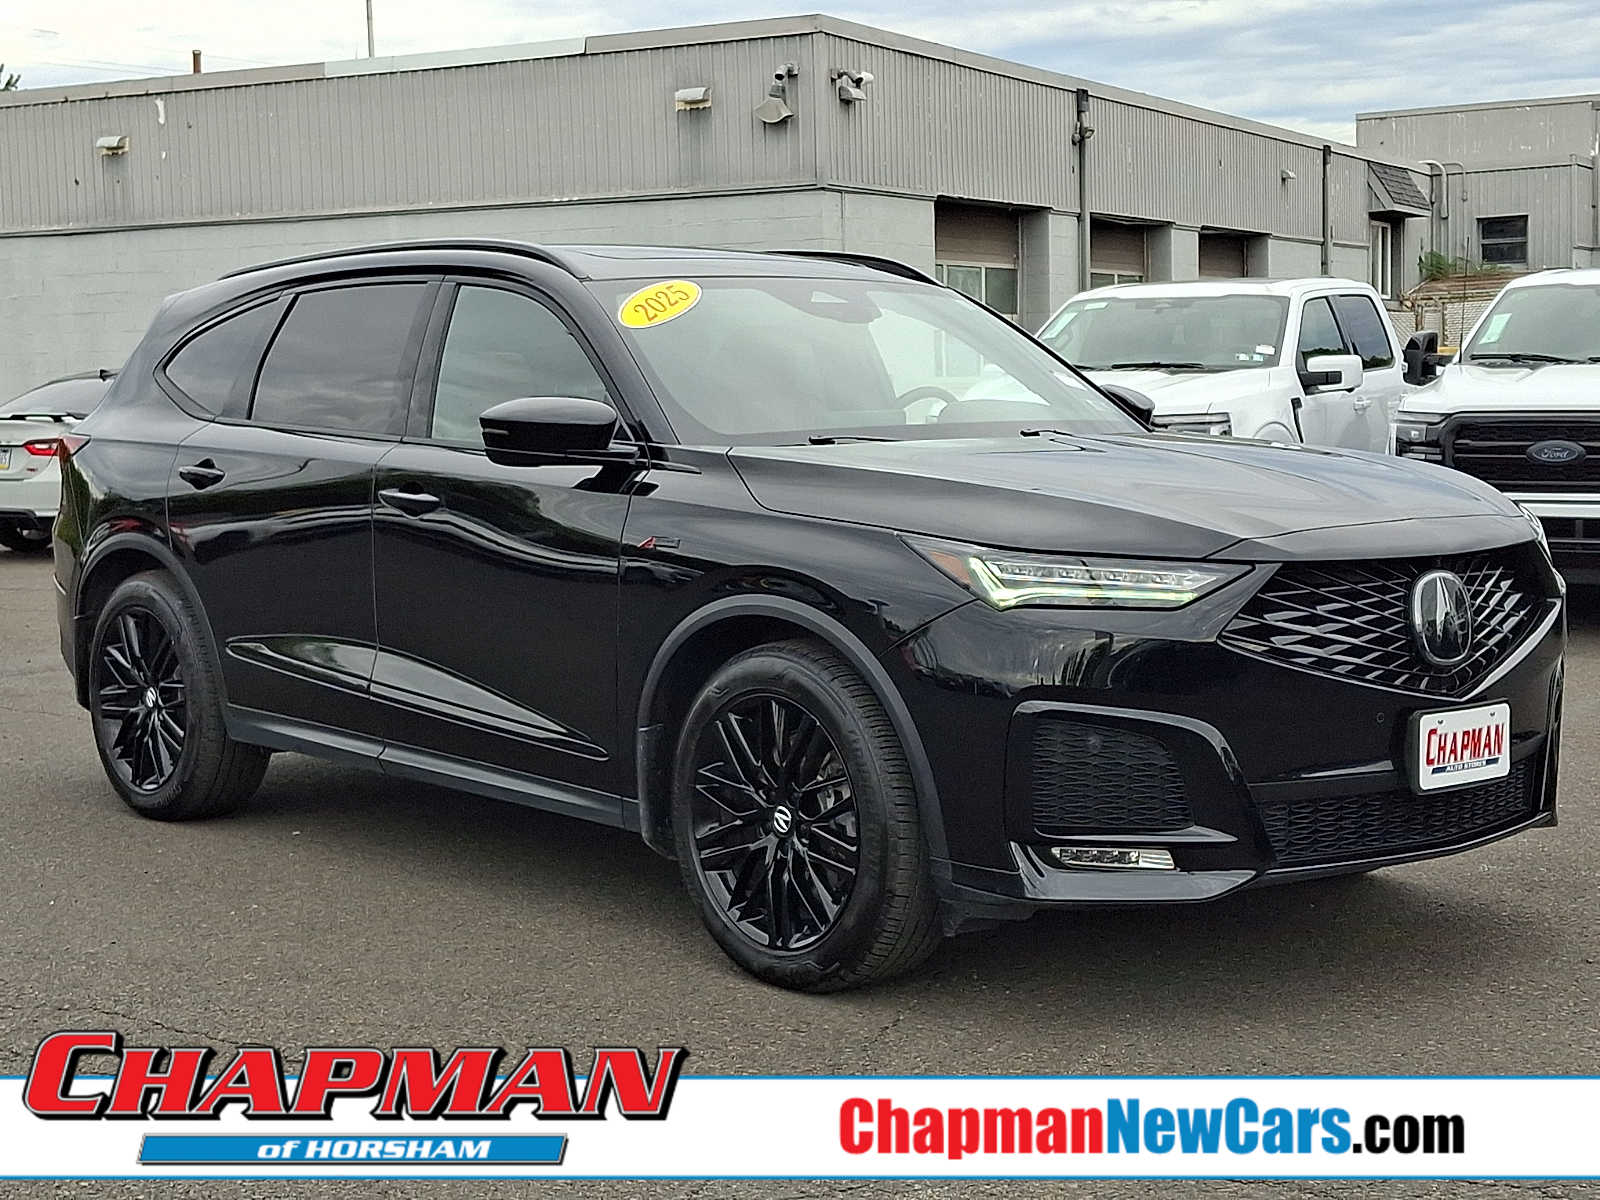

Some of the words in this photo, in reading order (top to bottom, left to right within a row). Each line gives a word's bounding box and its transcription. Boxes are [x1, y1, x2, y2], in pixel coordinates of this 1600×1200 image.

[633, 284, 690, 322] 2025
[1540, 446, 1570, 459] Ford
[1425, 723, 1505, 767] CHAPMAN
